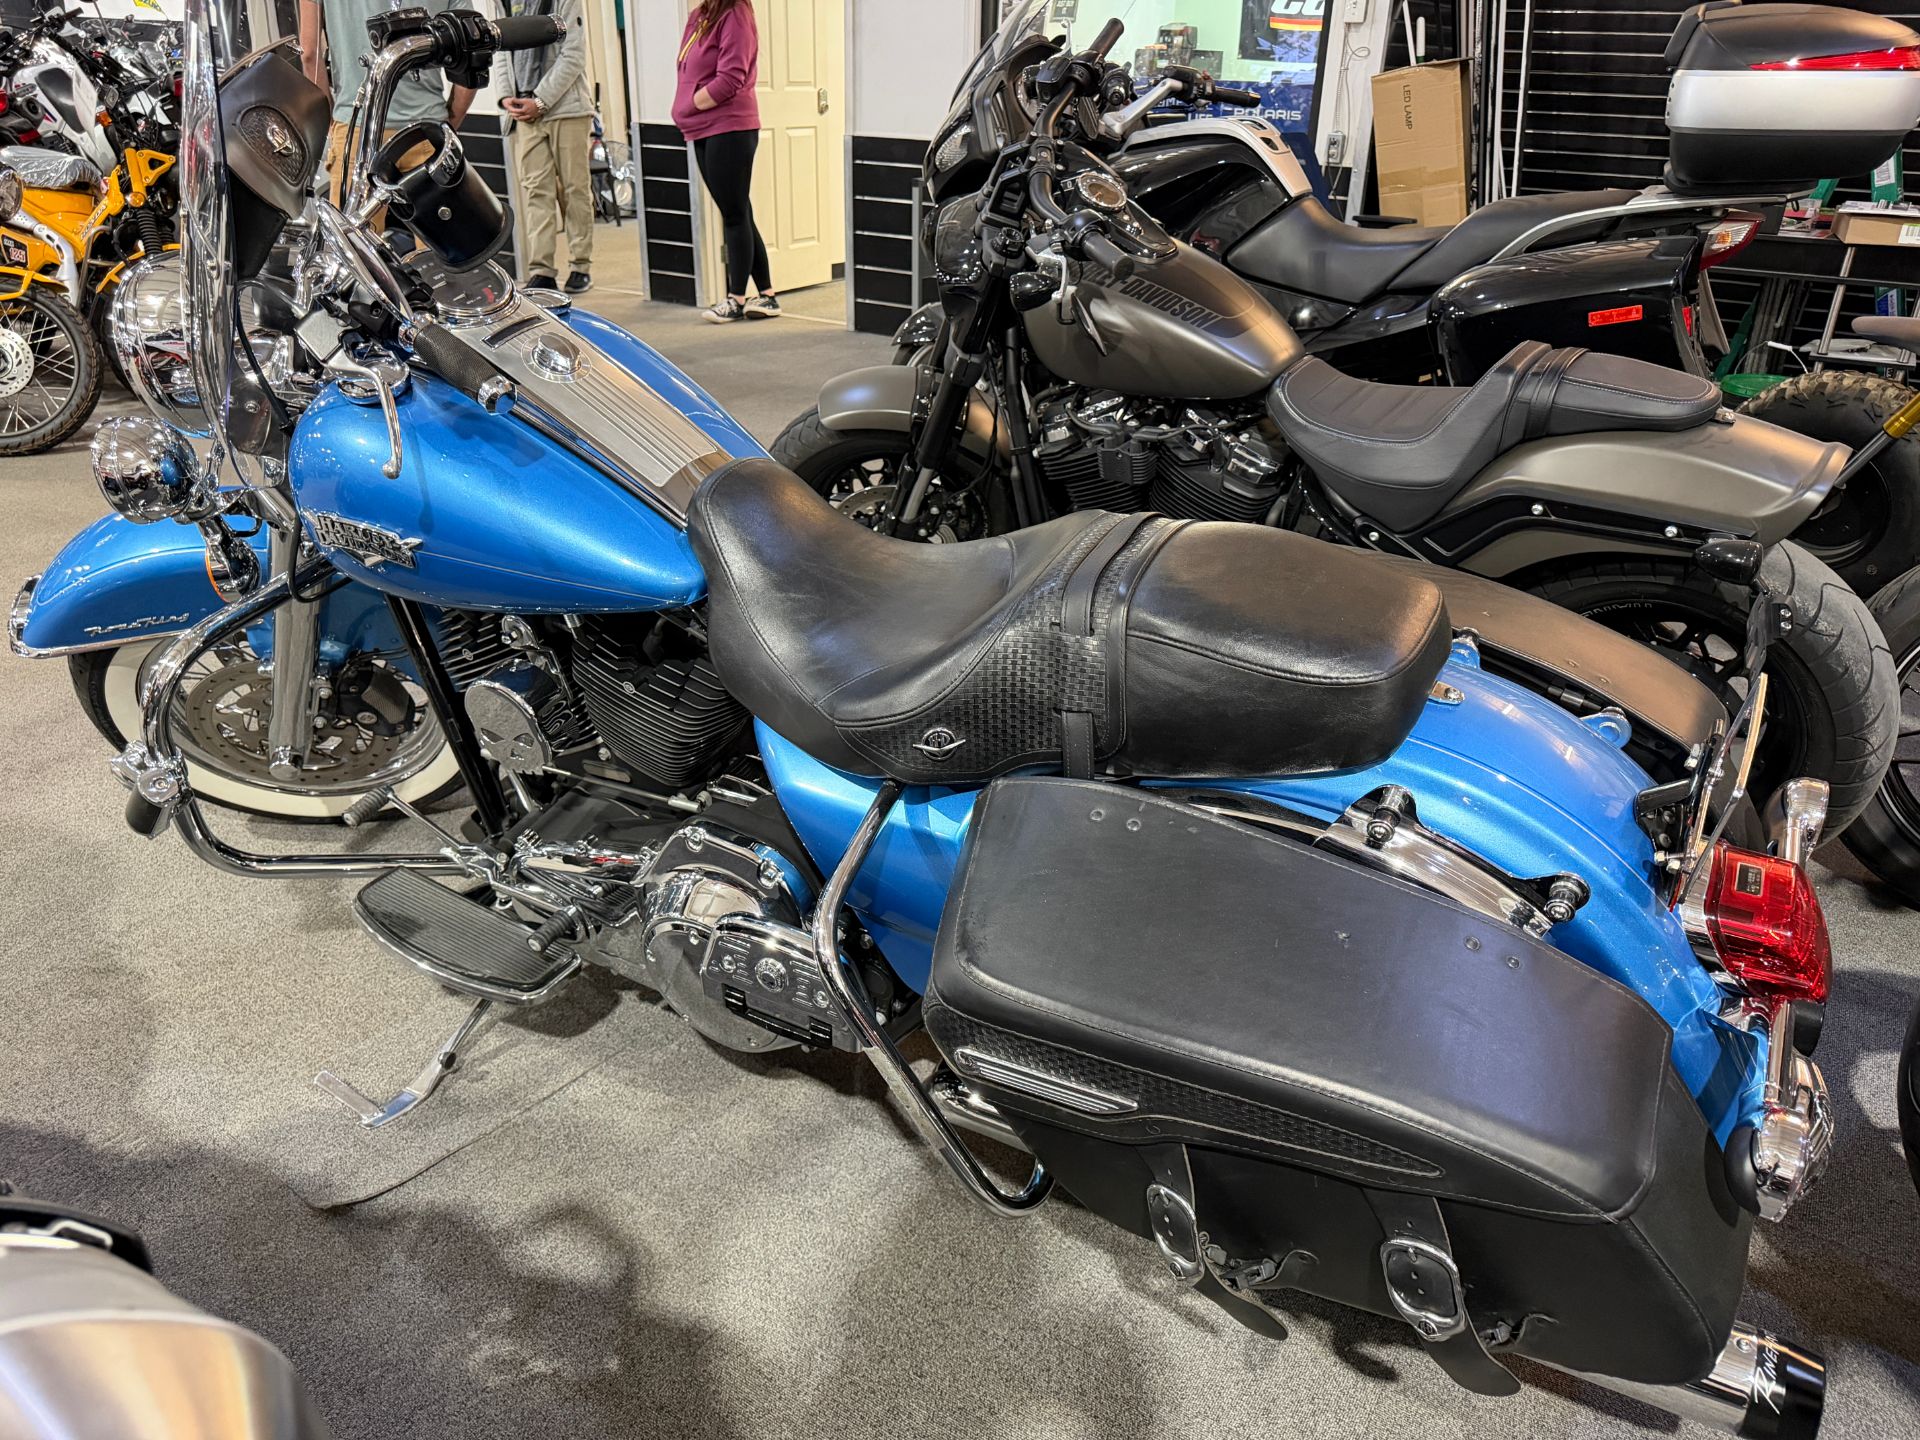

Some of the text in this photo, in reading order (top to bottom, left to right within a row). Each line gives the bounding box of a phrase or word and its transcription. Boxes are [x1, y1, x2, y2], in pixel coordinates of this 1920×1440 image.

[1233, 108, 1302, 121] POLARIS
[1403, 84, 1413, 130] LED LAMP
